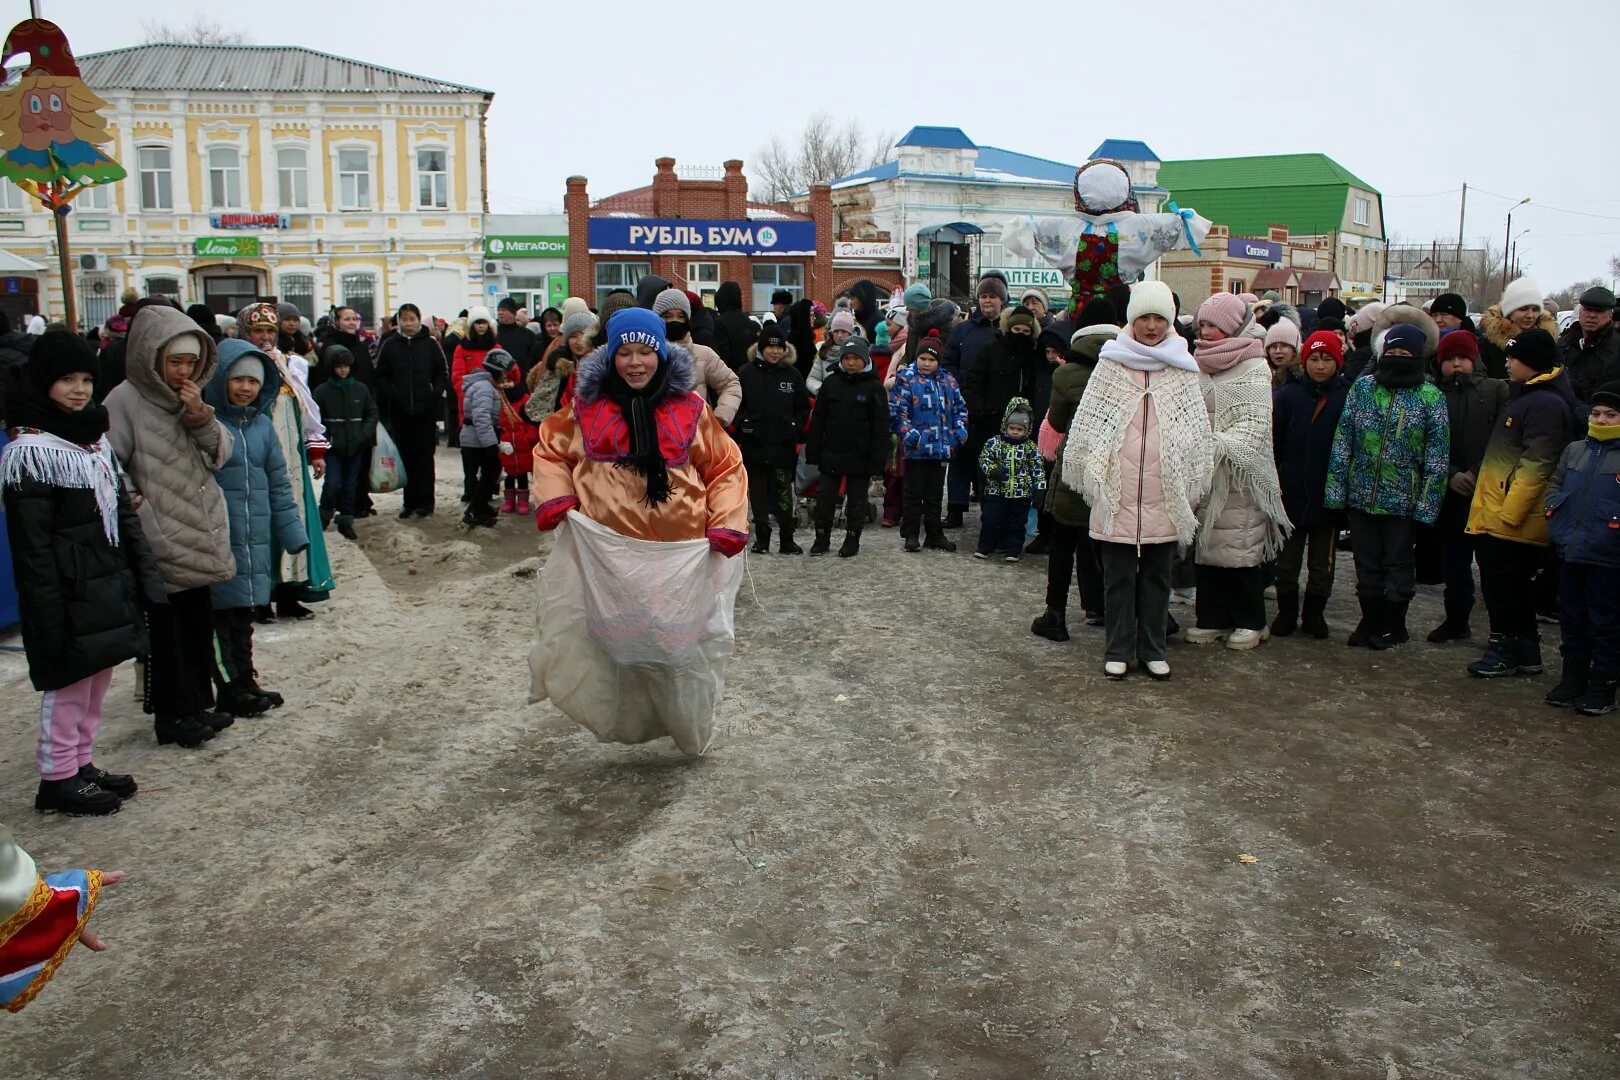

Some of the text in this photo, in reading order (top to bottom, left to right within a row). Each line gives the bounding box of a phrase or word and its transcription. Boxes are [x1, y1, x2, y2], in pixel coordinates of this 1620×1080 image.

[629, 225, 755, 246] РУБЛЬ БУМ
[841, 243, 896, 256] Для тебя
